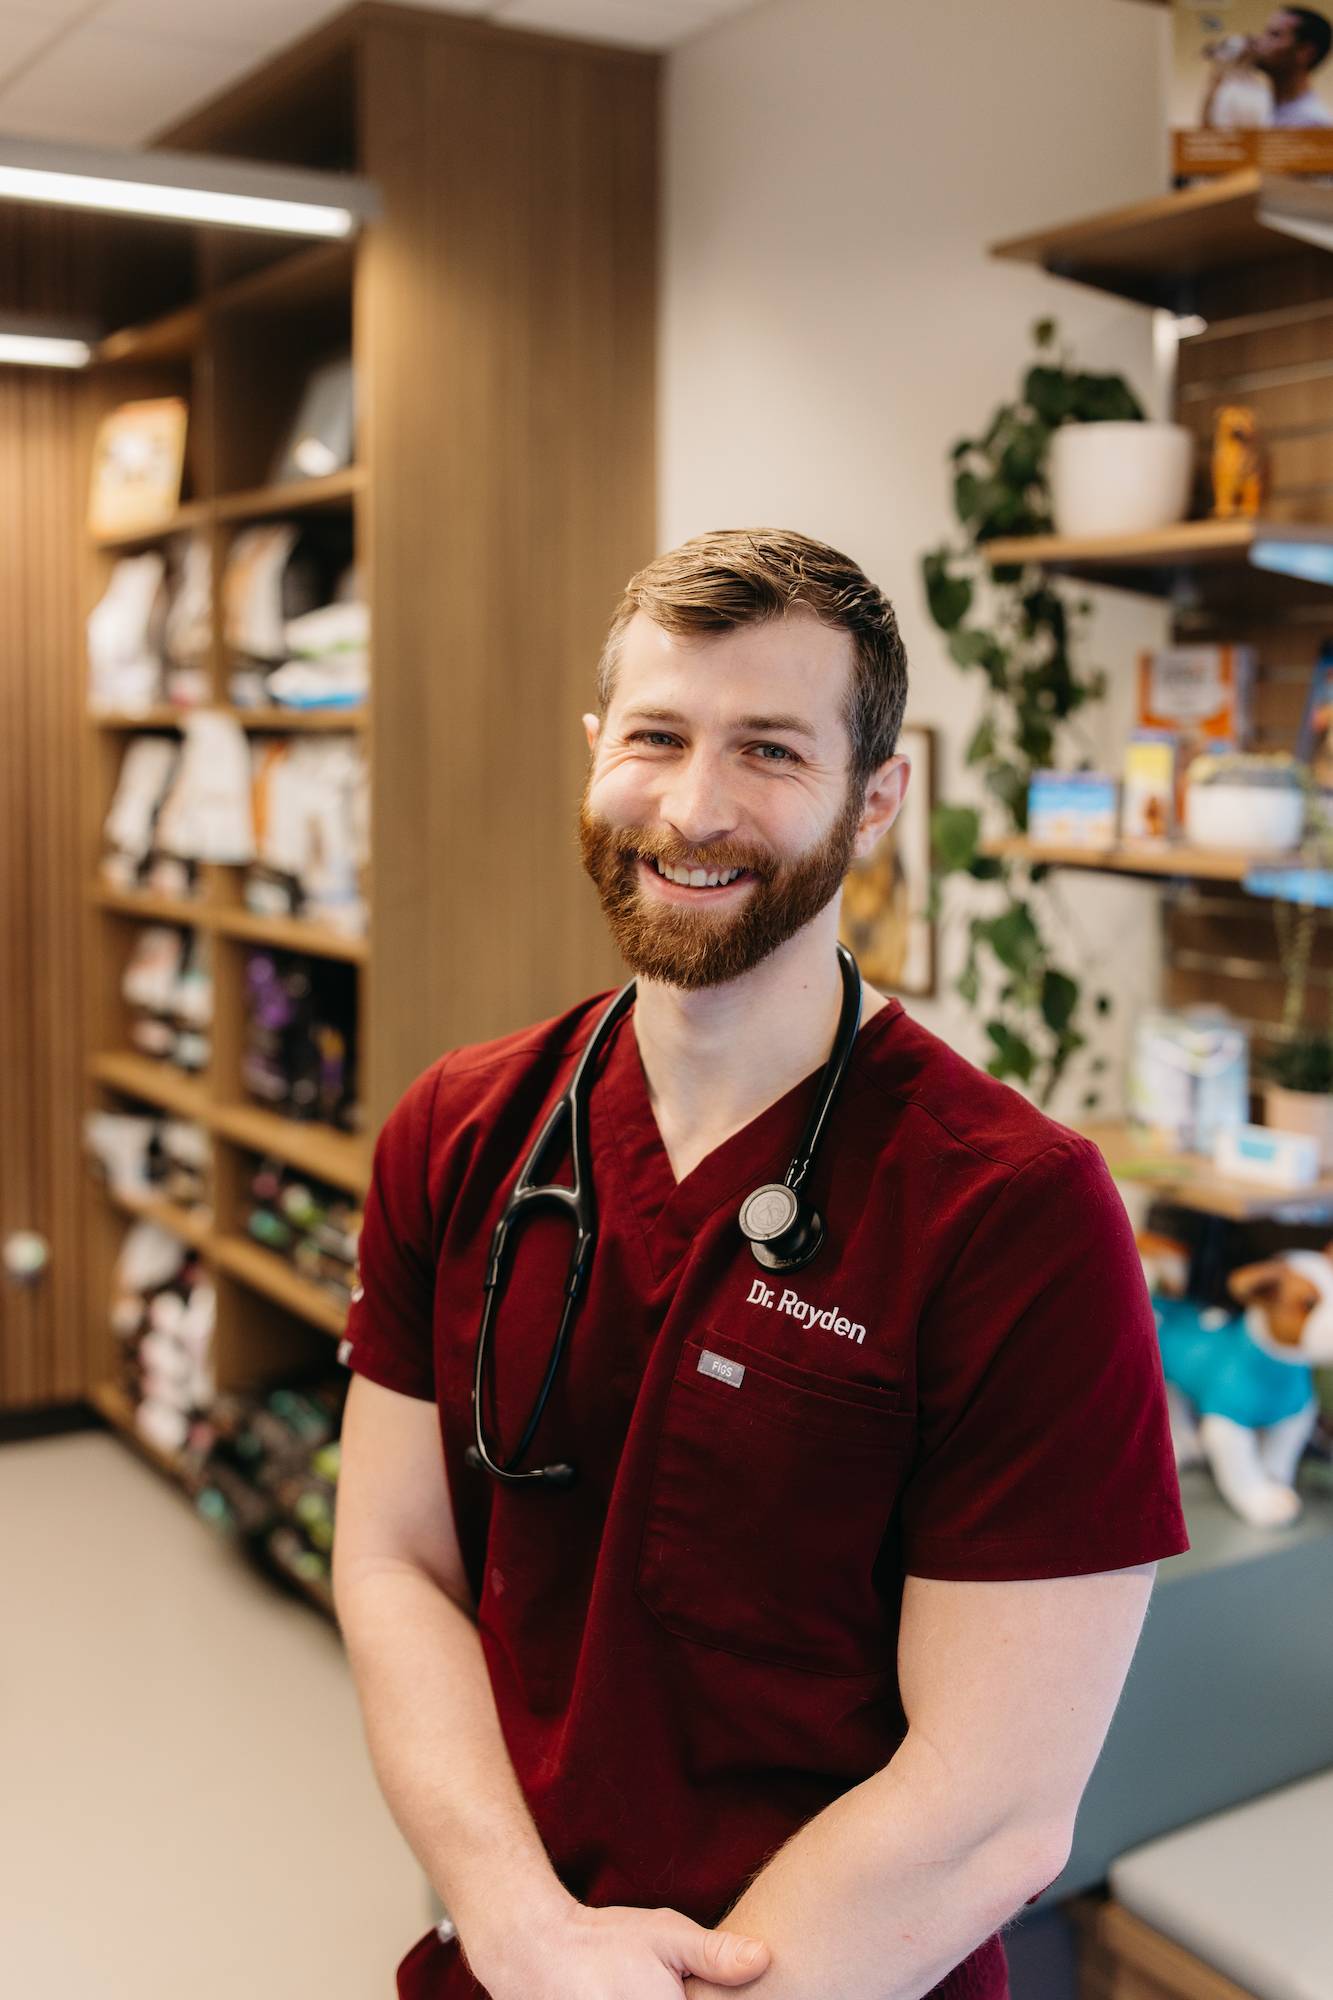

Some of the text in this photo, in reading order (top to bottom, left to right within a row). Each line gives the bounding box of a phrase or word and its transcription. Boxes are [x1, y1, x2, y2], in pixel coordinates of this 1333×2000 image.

[746, 1279, 867, 1344] Dr. Rayden
[712, 1361, 733, 1377] FIGS
